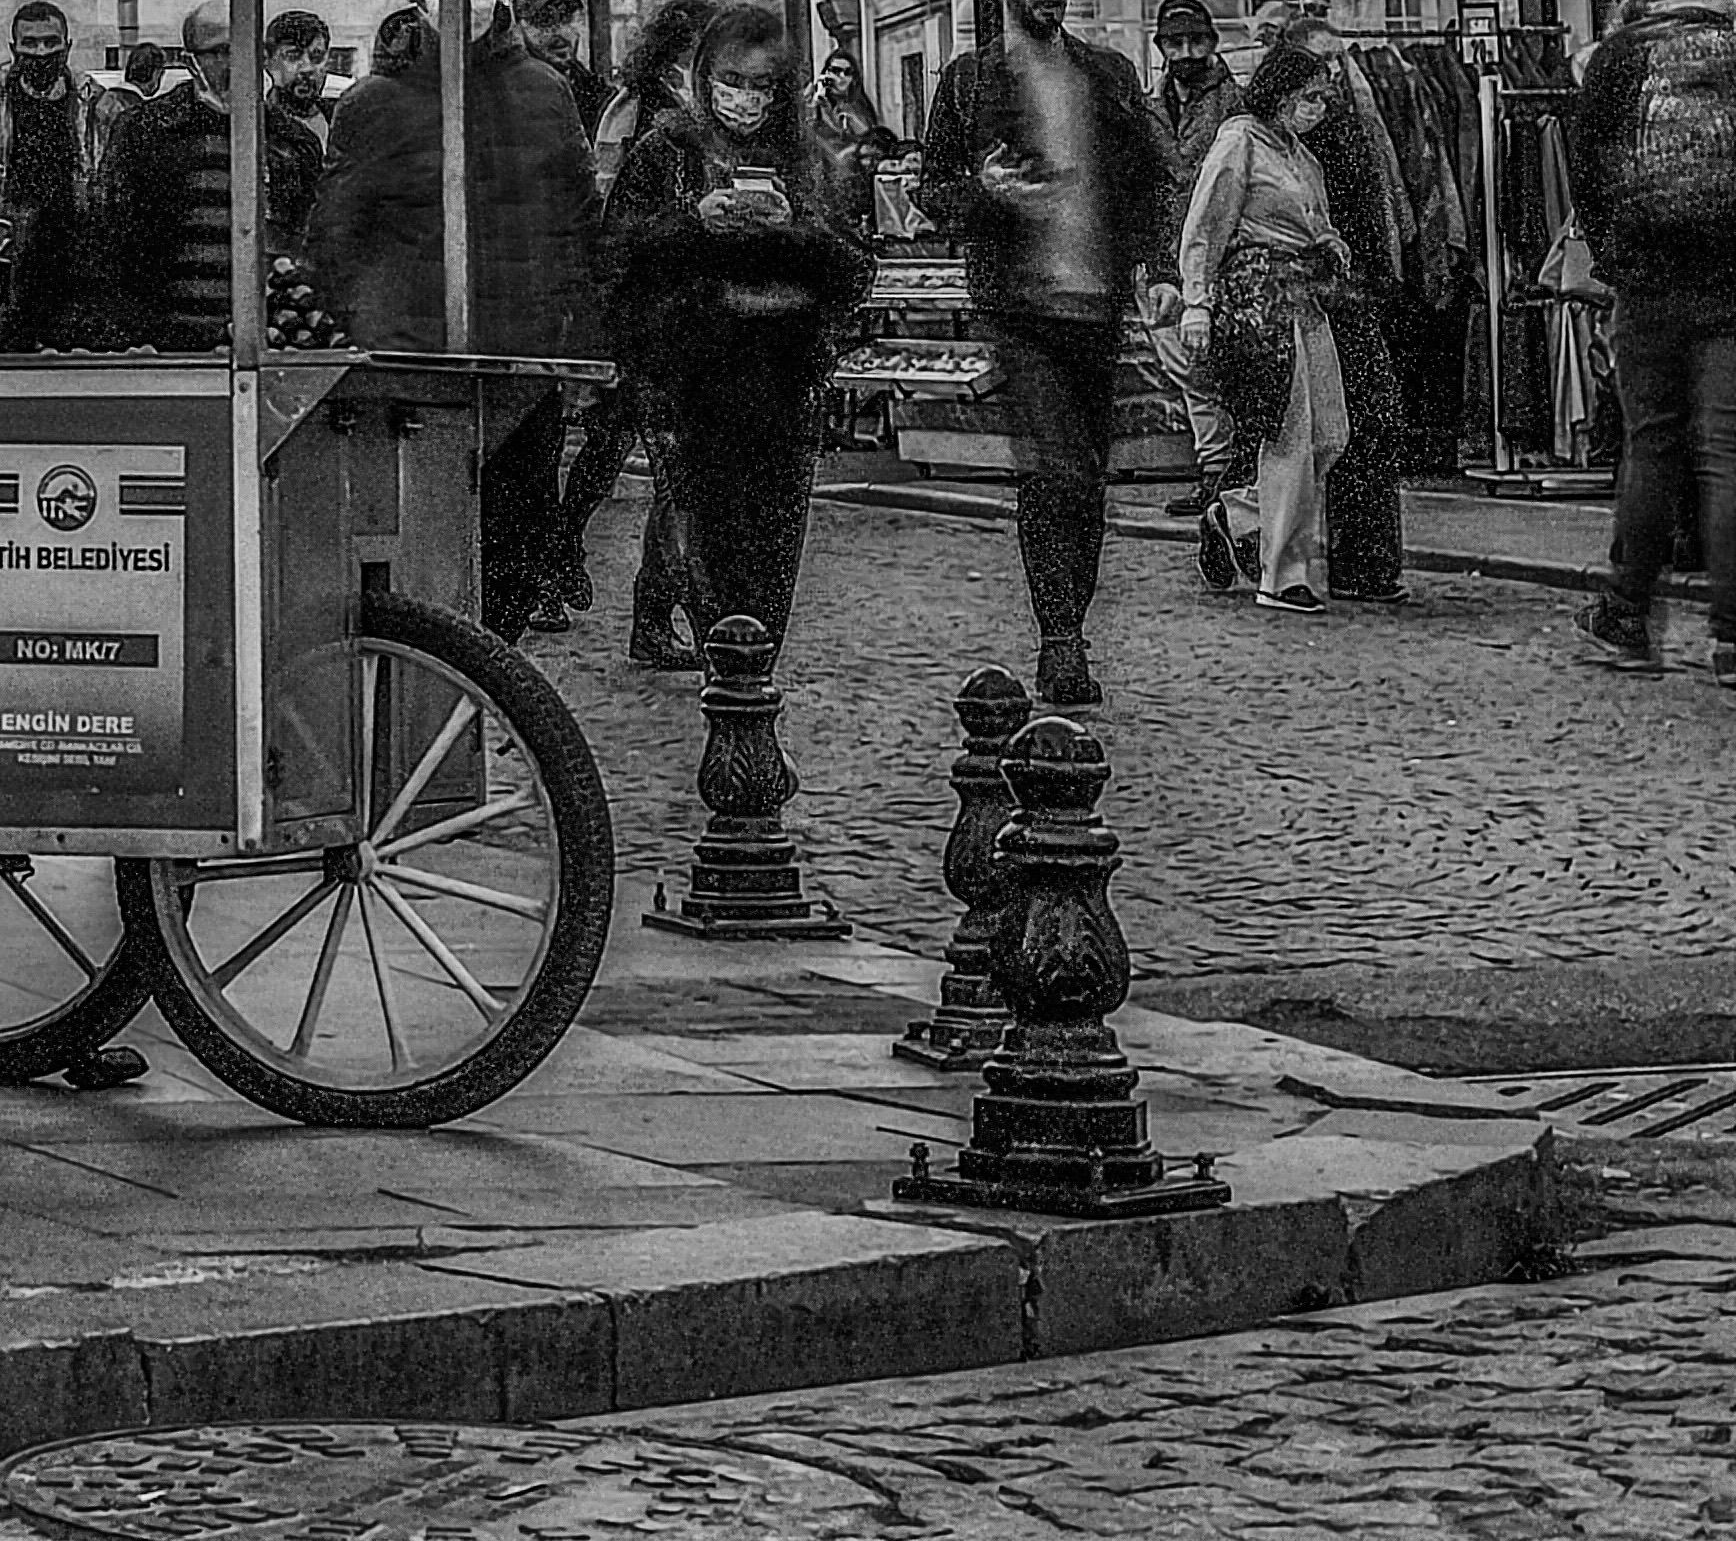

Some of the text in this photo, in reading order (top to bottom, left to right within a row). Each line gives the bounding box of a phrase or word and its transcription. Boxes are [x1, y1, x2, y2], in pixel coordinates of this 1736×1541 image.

[37, 541, 170, 572] BELEDİYESİ
[1, 710, 134, 734] ENGİN DERE
